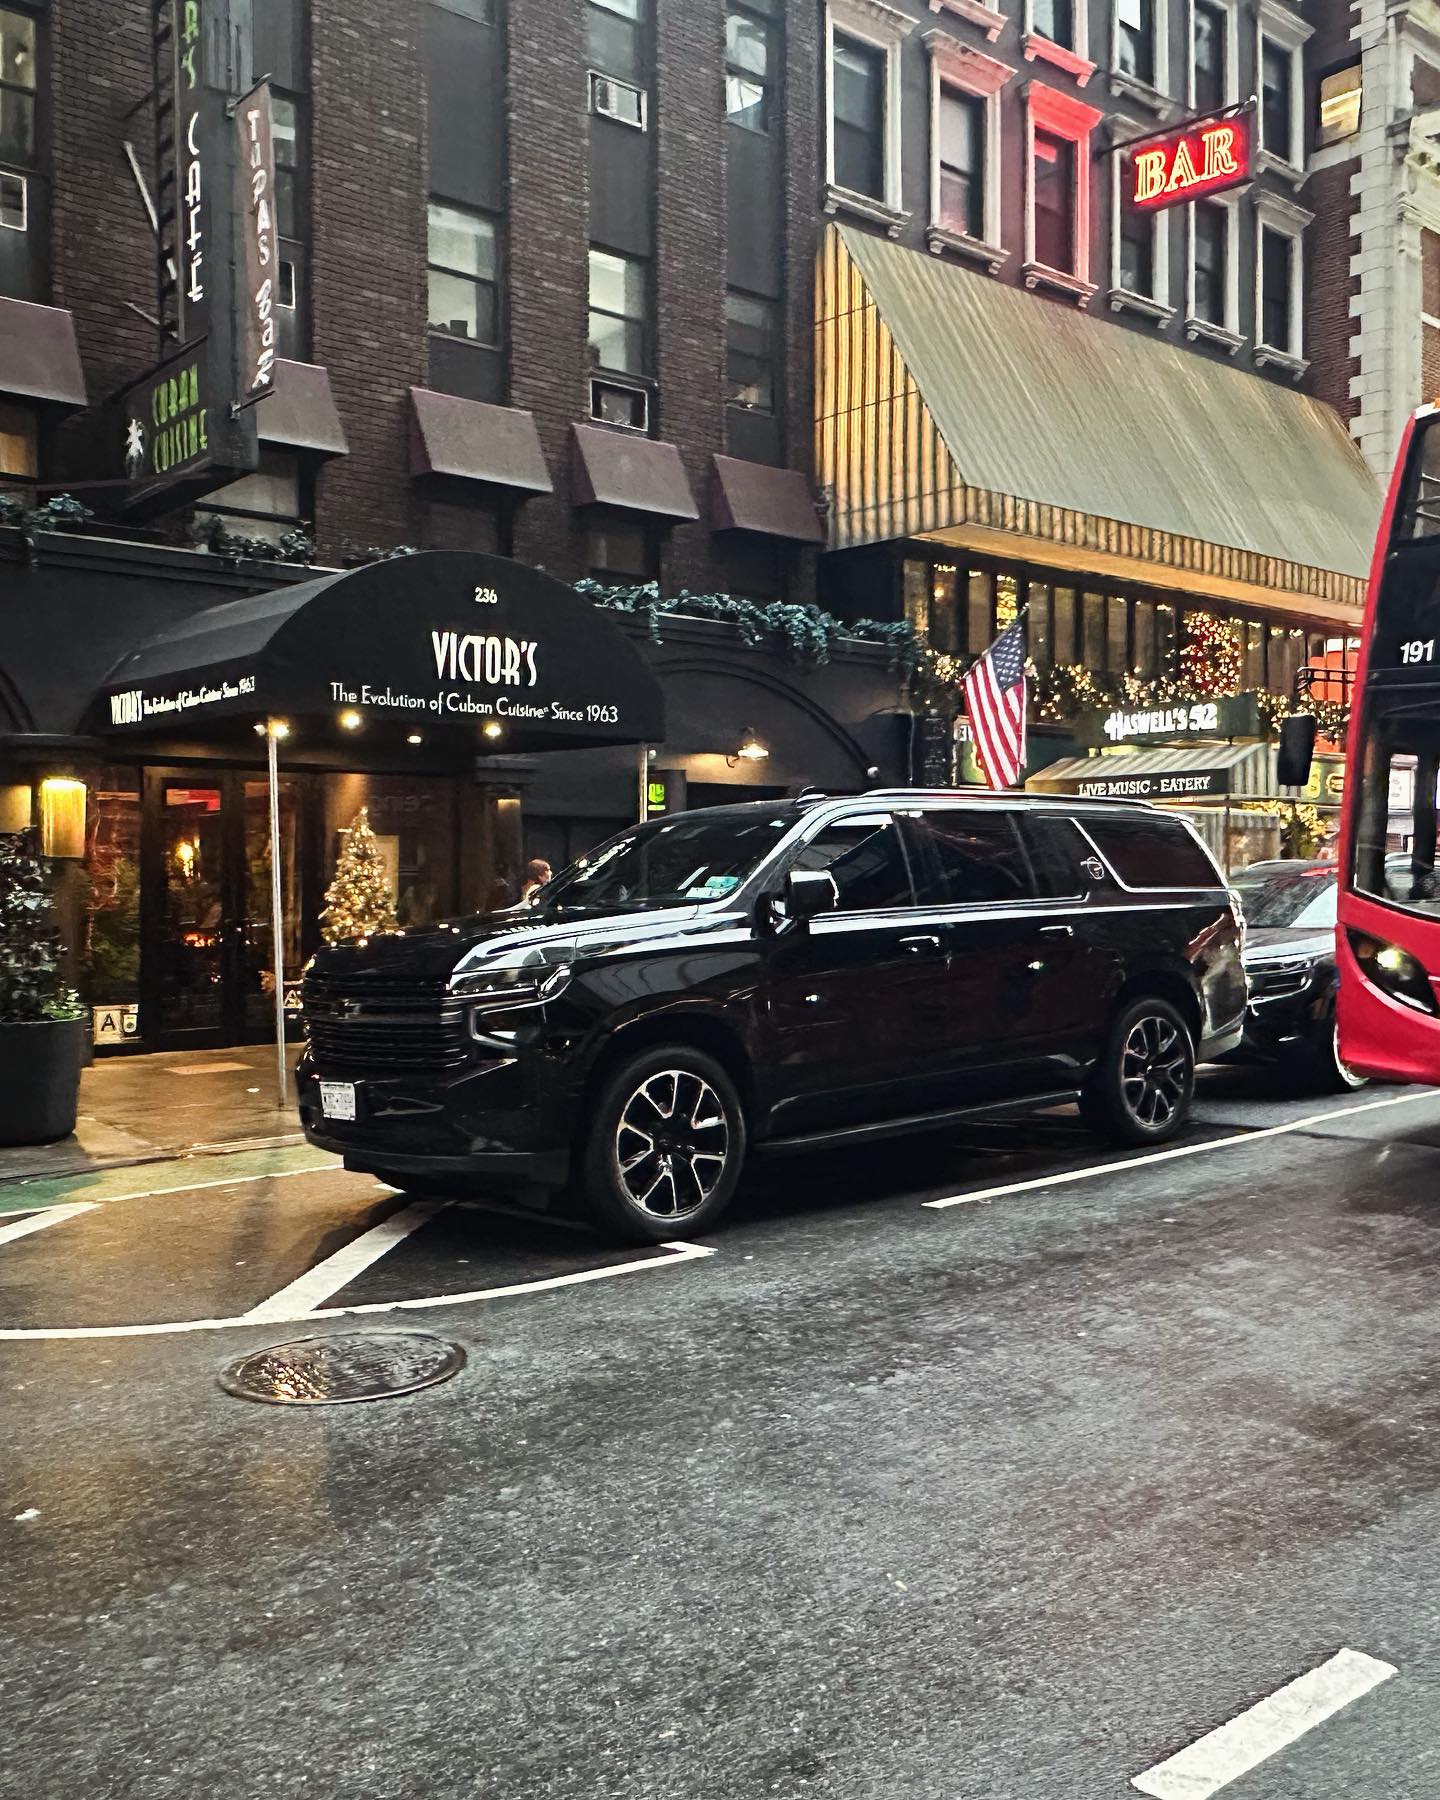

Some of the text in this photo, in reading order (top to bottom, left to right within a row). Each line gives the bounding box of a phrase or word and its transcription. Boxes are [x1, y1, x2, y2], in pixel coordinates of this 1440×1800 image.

[1133, 127, 1238, 203] BAR
[474, 586, 498, 604] 236
[431, 630, 538, 687] VICTOR'S
[1400, 639, 1436, 664] 191
[330, 681, 358, 703] The
[360, 685, 426, 709] Evolution
[429, 691, 445, 715] of
[446, 693, 493, 715] Cuban
[551, 701, 584, 721] Since
[586, 704, 619, 723] 1963
[1188, 702, 1218, 731] 52
[1078, 782, 1107, 797] LIVE
[1107, 779, 1151, 796] MUSIC
[1159, 776, 1211, 793] EATERY
